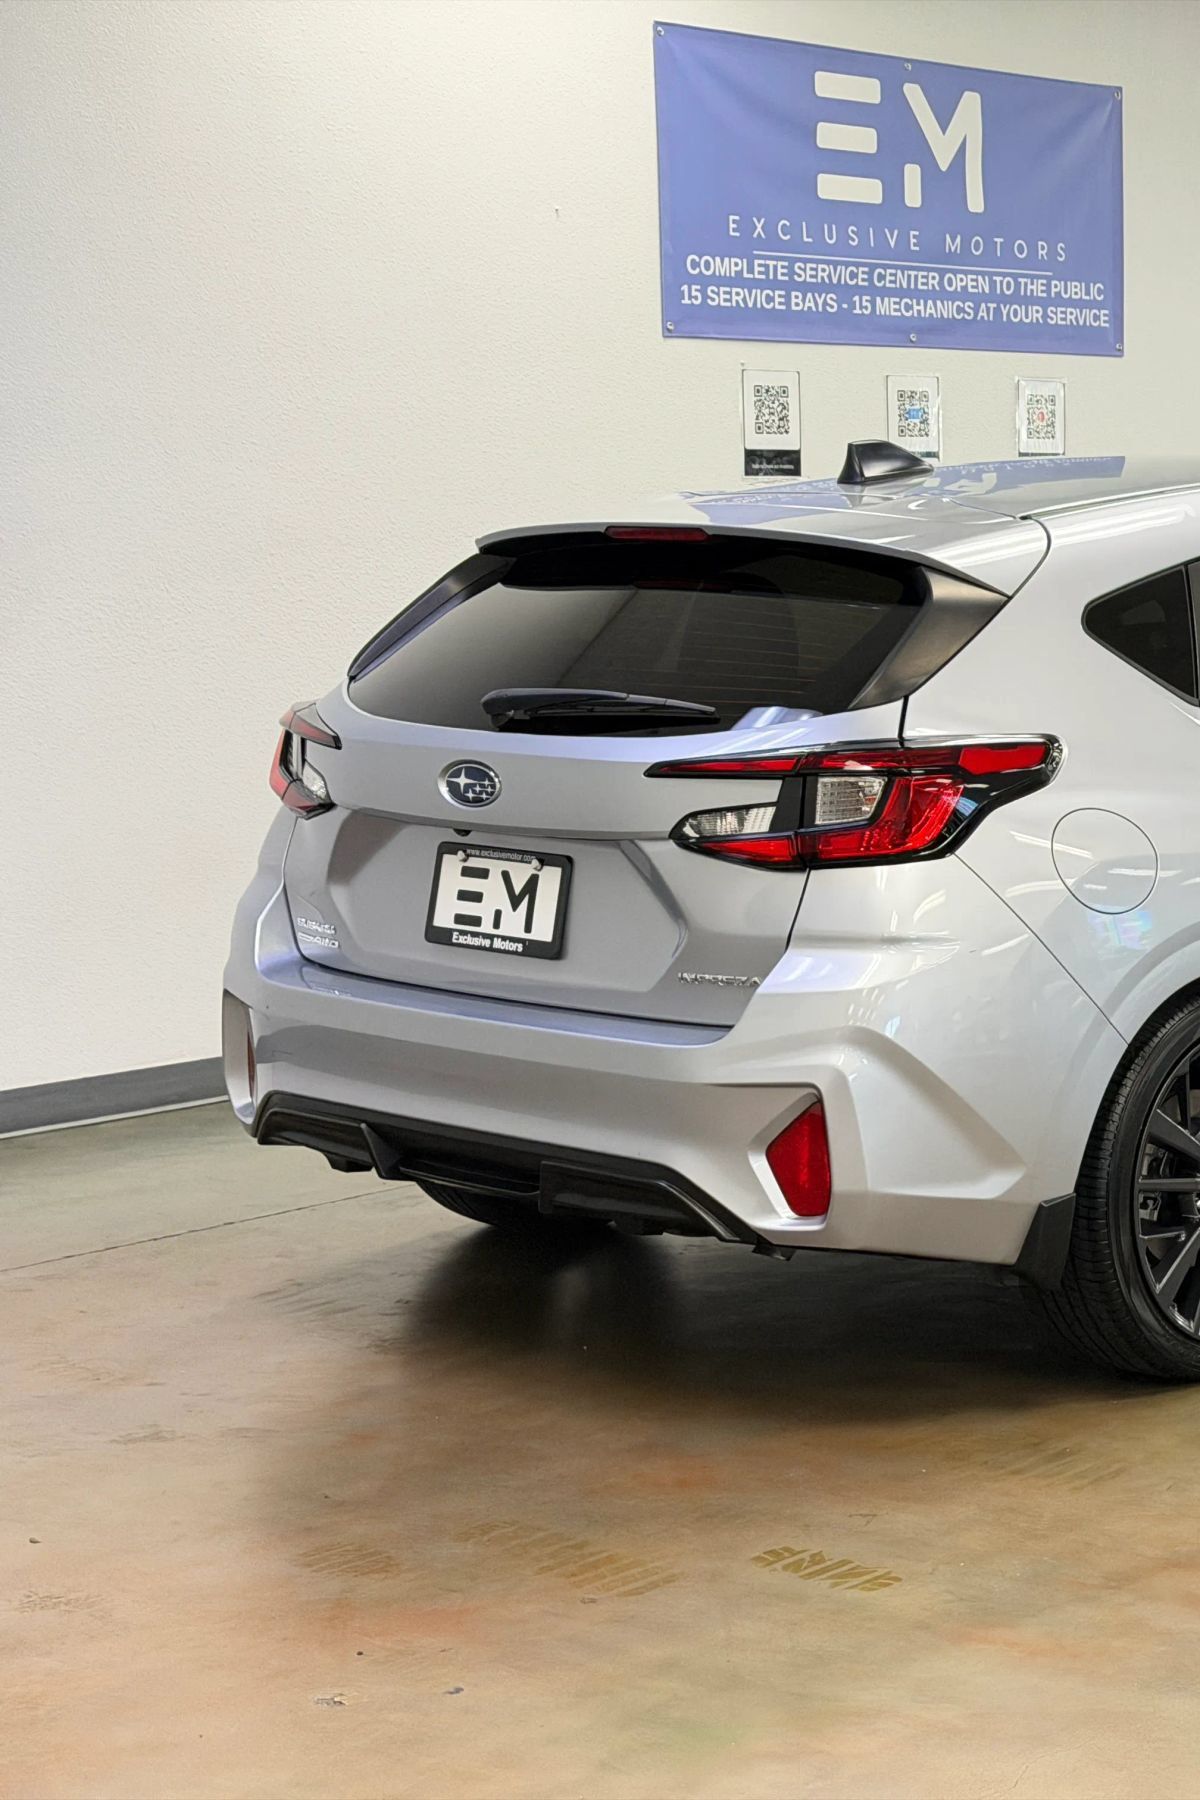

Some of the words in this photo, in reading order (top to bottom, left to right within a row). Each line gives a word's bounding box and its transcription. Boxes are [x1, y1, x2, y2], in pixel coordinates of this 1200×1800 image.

[814, 71, 985, 213] EM
[729, 215, 920, 250] EXCLUSIVE
[945, 233, 1066, 261] MOTORS
[686, 254, 789, 281] COMPLETE
[793, 262, 869, 286] SERVICE
[873, 268, 940, 291] CENTER
[943, 272, 990, 294] OPEN
[993, 276, 1015, 295] TO
[1018, 277, 1047, 297] THE
[1051, 280, 1104, 301] PUBLIC
[681, 284, 701, 305] 15
[707, 285, 786, 310] SERVICE
[791, 291, 838, 313] BAYS
[852, 295, 871, 315] 15
[876, 296, 974, 320] MECHANICS
[977, 302, 997, 321] AT
[1000, 304, 1043, 324] YOUR
[1047, 307, 1110, 327] SERVICE
[454, 865, 540, 934] EM
[452, 931, 491, 948] Exclusive
[492, 937, 523, 952] Motors
